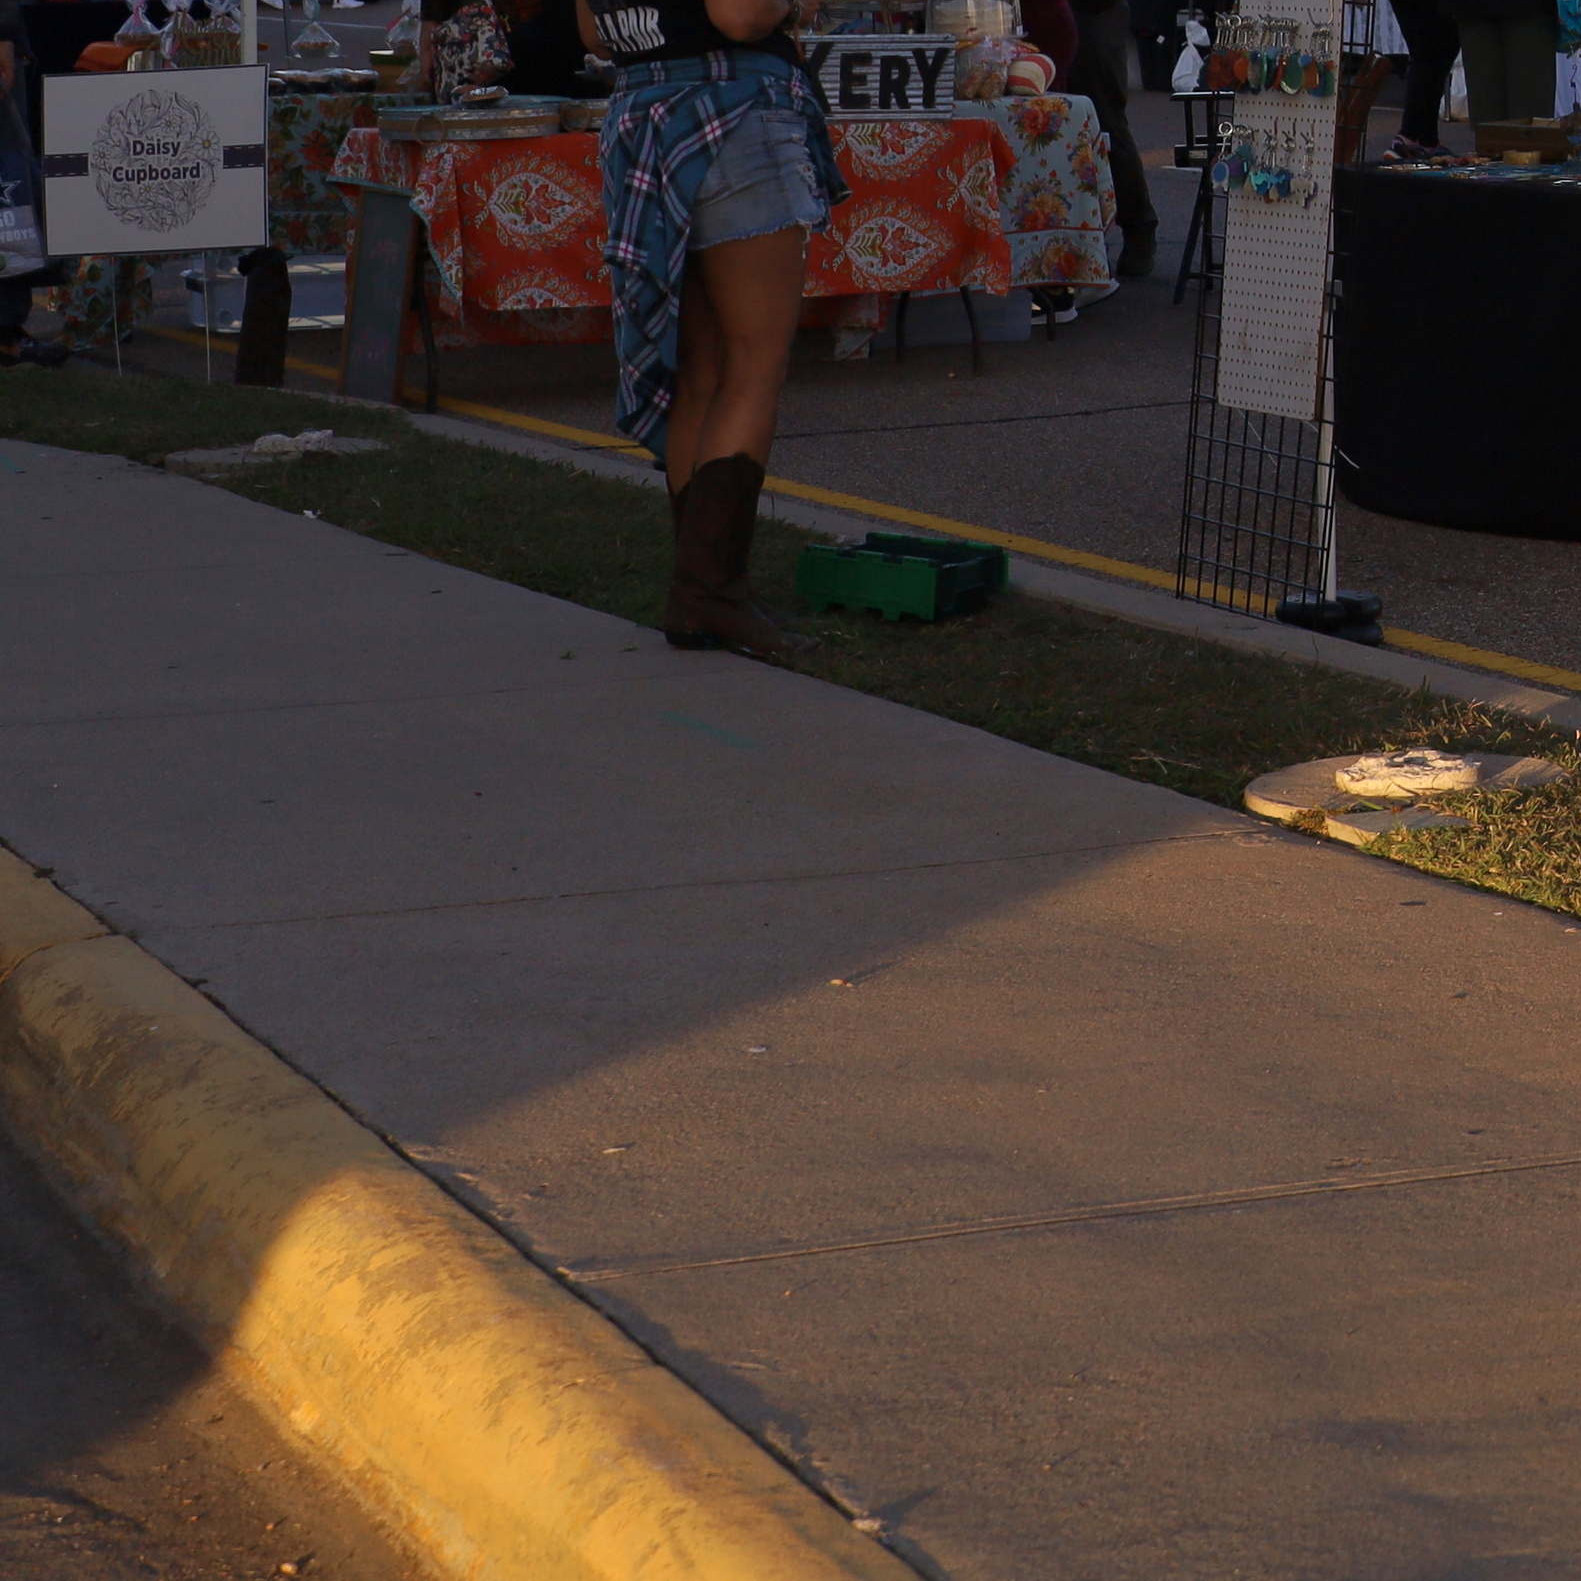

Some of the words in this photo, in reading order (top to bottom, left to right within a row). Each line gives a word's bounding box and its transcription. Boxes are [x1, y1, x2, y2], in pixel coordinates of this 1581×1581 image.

[616, 6, 666, 52] PAIR
[132, 138, 181, 157] Daisy
[112, 161, 201, 185] Cupboard
